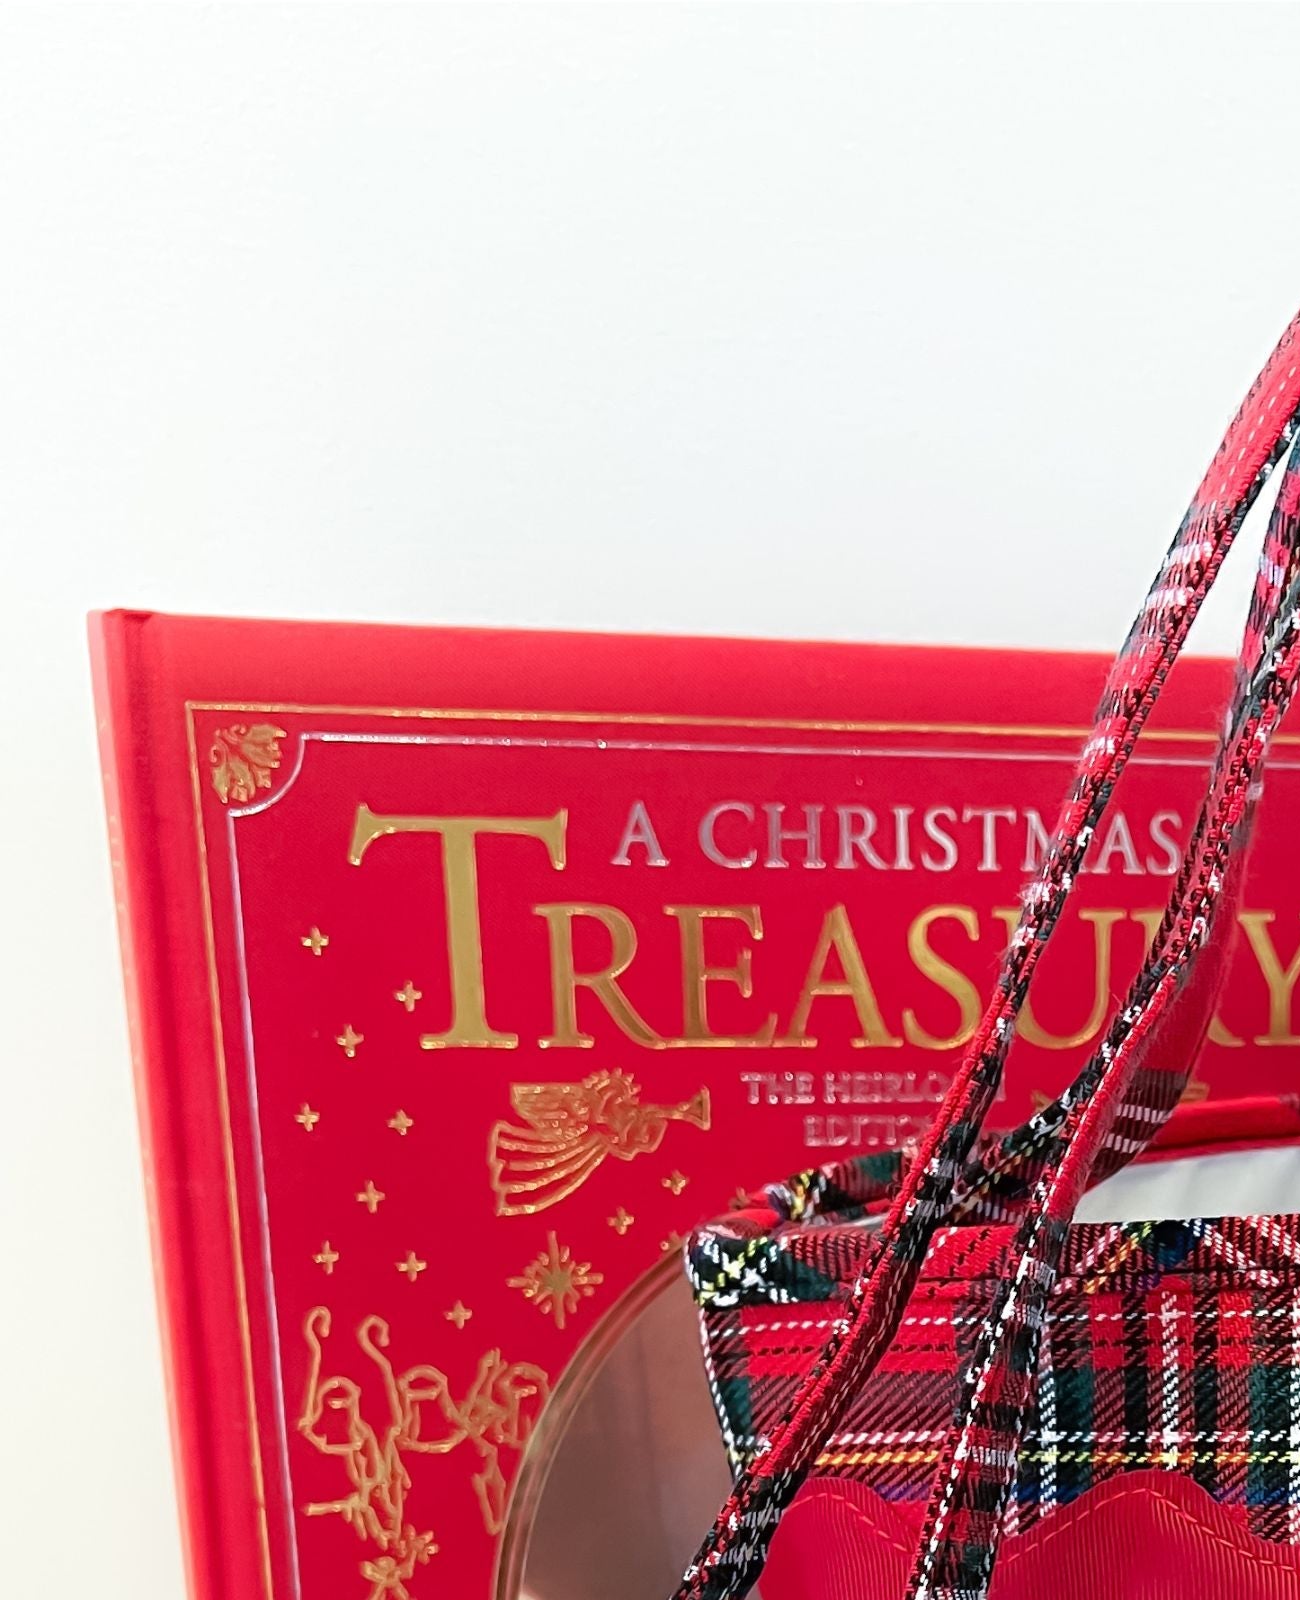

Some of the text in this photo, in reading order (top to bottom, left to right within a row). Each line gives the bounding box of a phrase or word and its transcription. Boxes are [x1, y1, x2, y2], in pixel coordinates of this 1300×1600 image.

[610, 800, 670, 866] A
[740, 1071, 1006, 1104] THE HEIRLO
[804, 1113, 934, 1147] EDITIO
